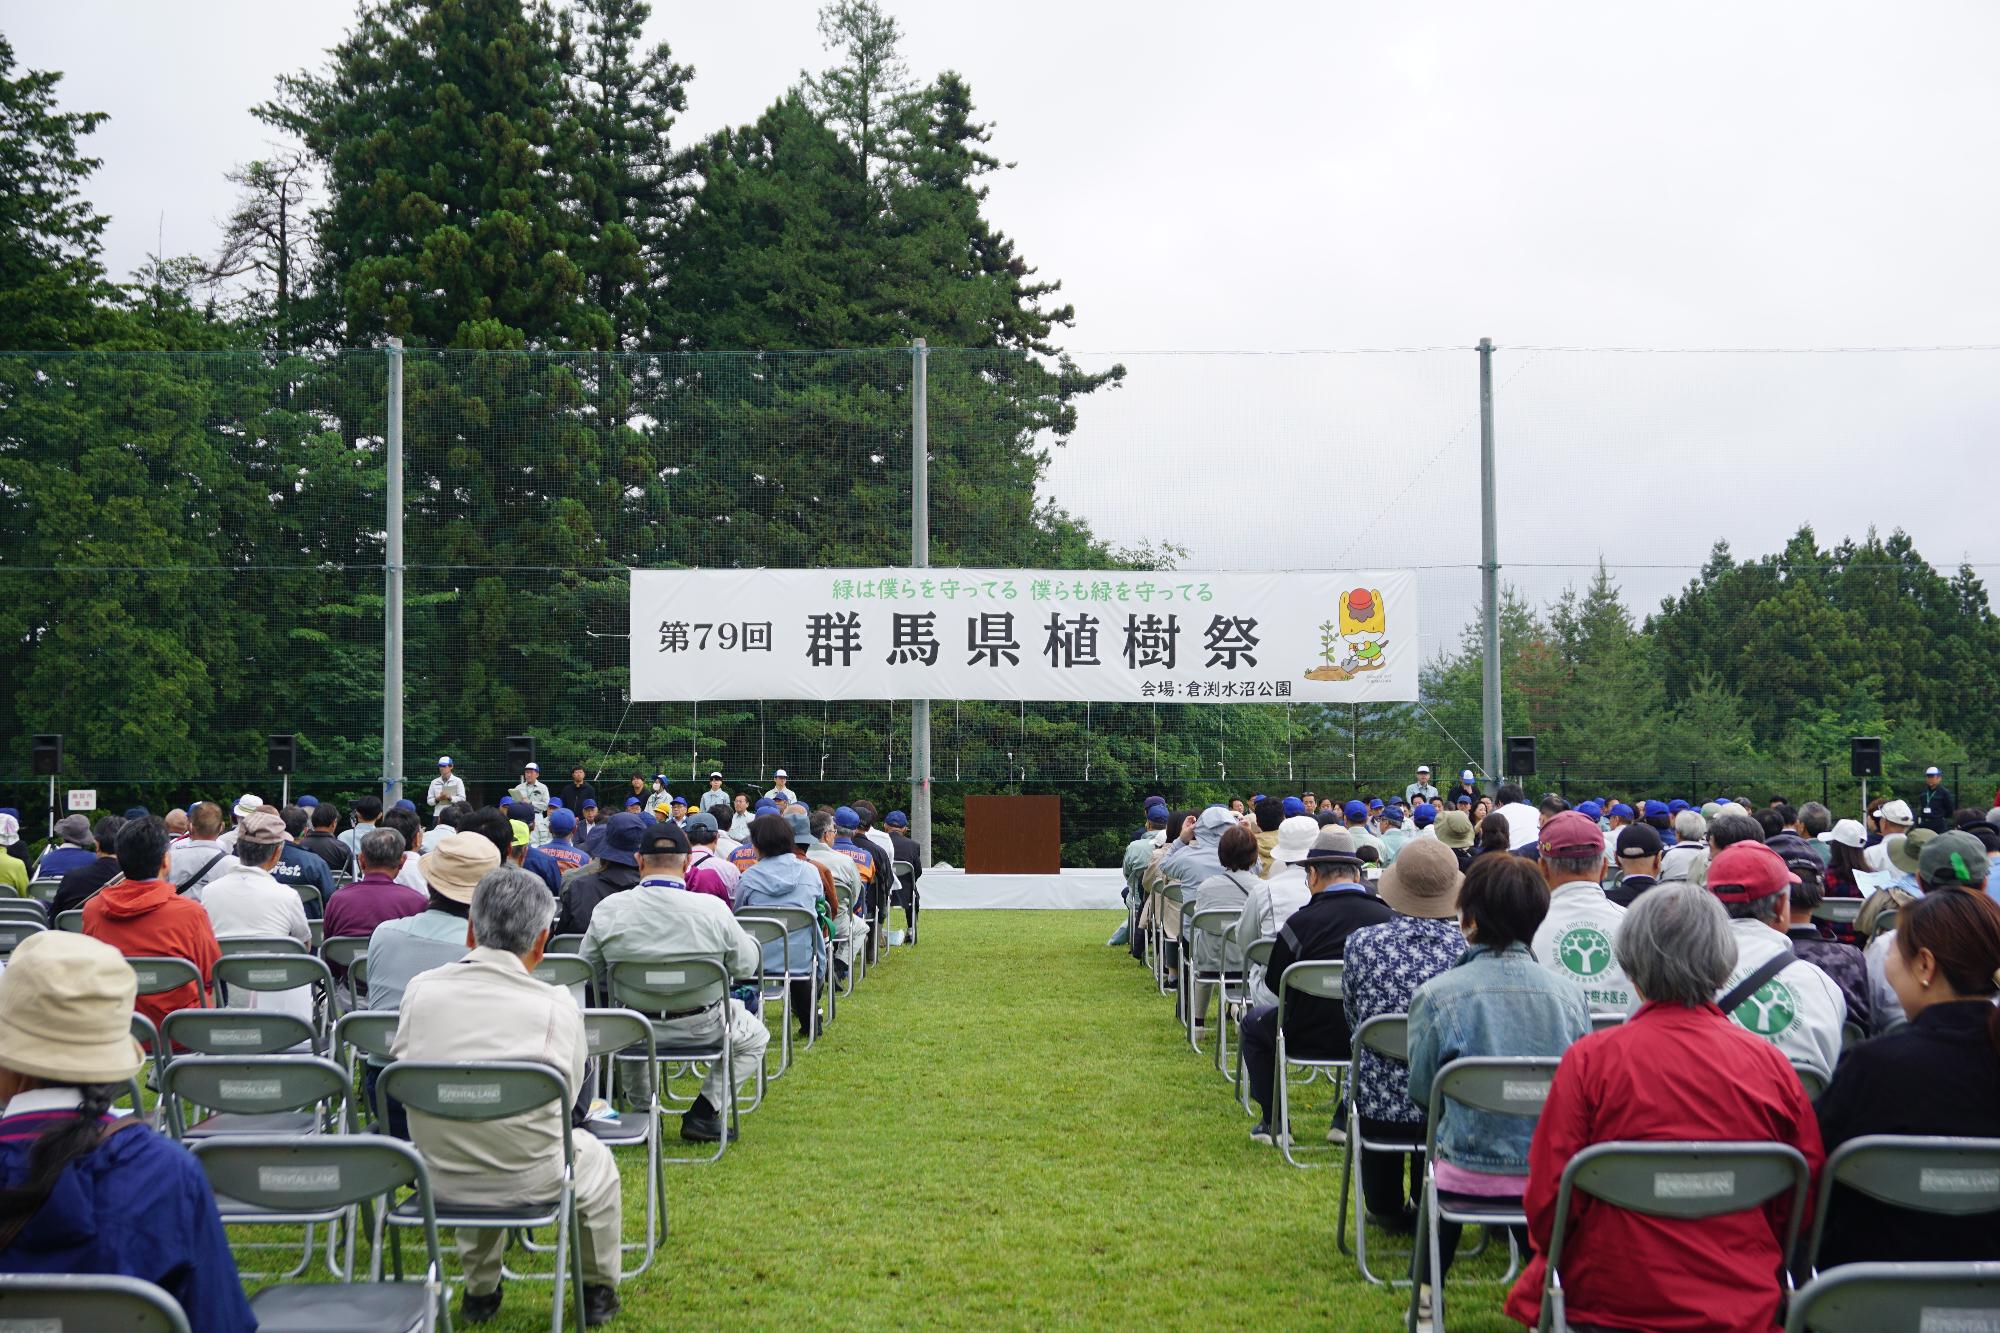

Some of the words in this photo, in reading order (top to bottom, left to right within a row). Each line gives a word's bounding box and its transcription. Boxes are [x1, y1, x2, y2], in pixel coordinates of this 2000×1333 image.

[832, 578, 1018, 600] 緑は僕らを守ってる
[1030, 580, 1214, 602] 僕らも緑を守ってる
[658, 620, 773, 653] 第79回
[805, 610, 1261, 669] 群馬県植樹祭
